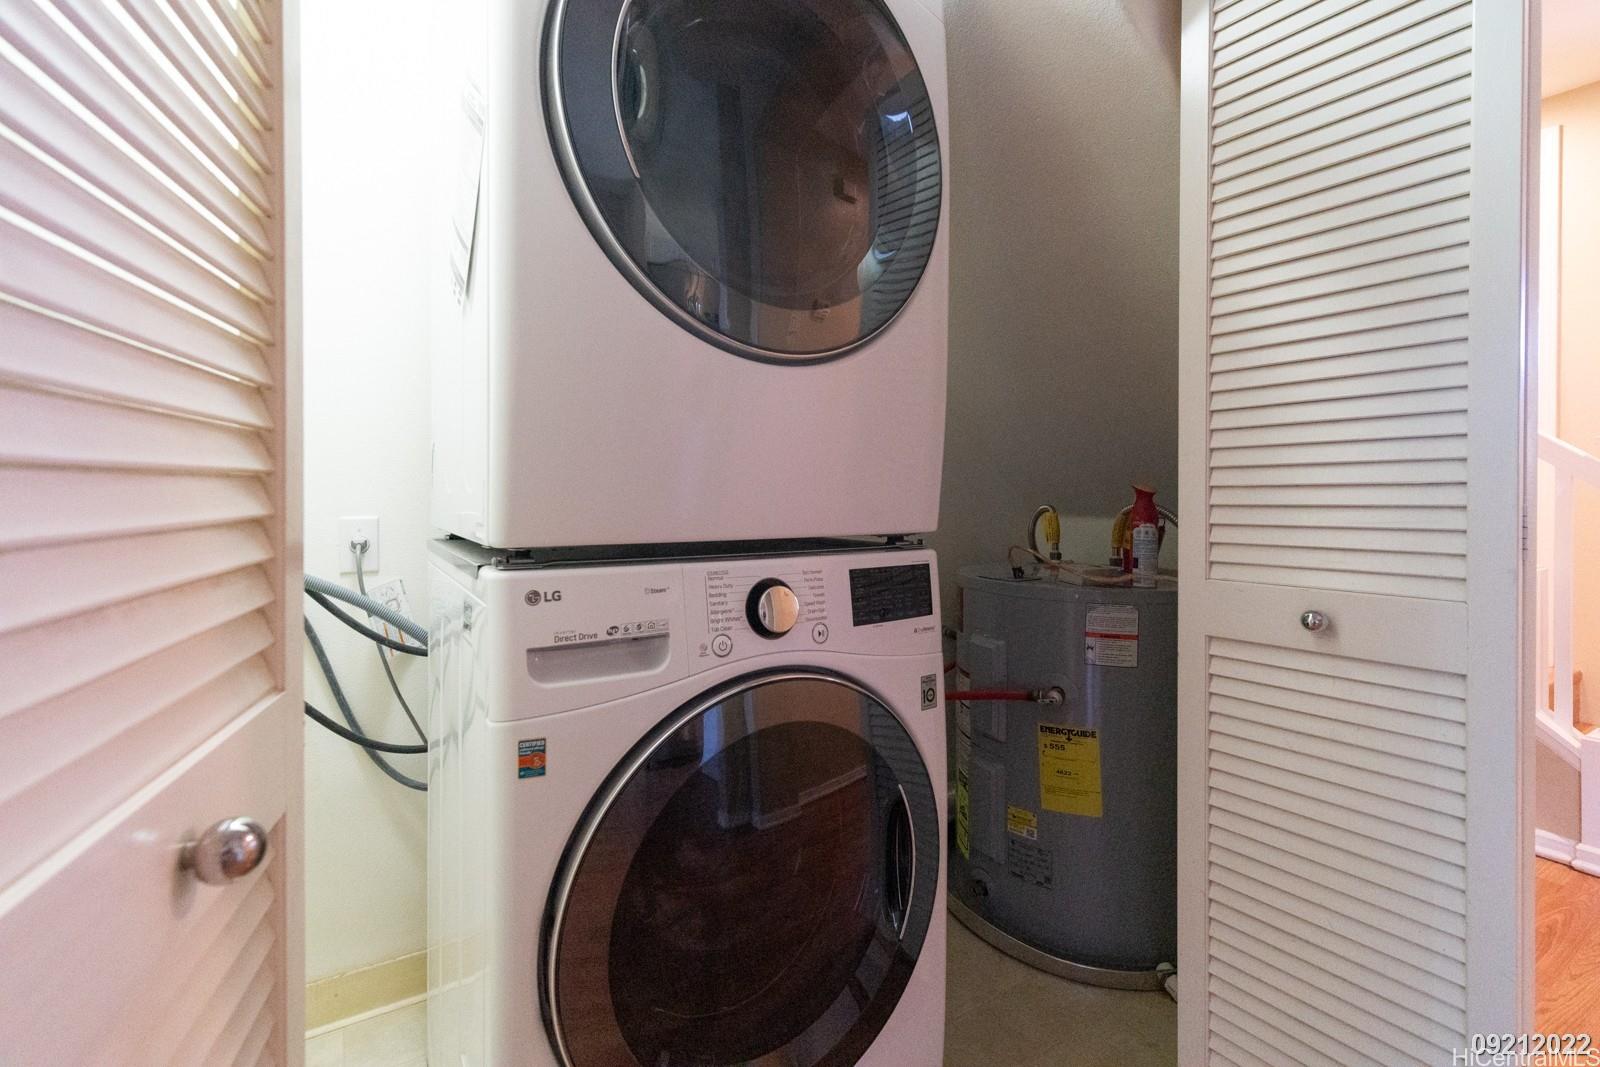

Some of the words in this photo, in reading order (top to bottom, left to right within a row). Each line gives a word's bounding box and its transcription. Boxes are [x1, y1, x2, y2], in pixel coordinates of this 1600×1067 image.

[543, 590, 562, 602] LG
[553, 634, 577, 643] Direct
[578, 632, 598, 640] Drive
[1049, 743, 1066, 751] 555
